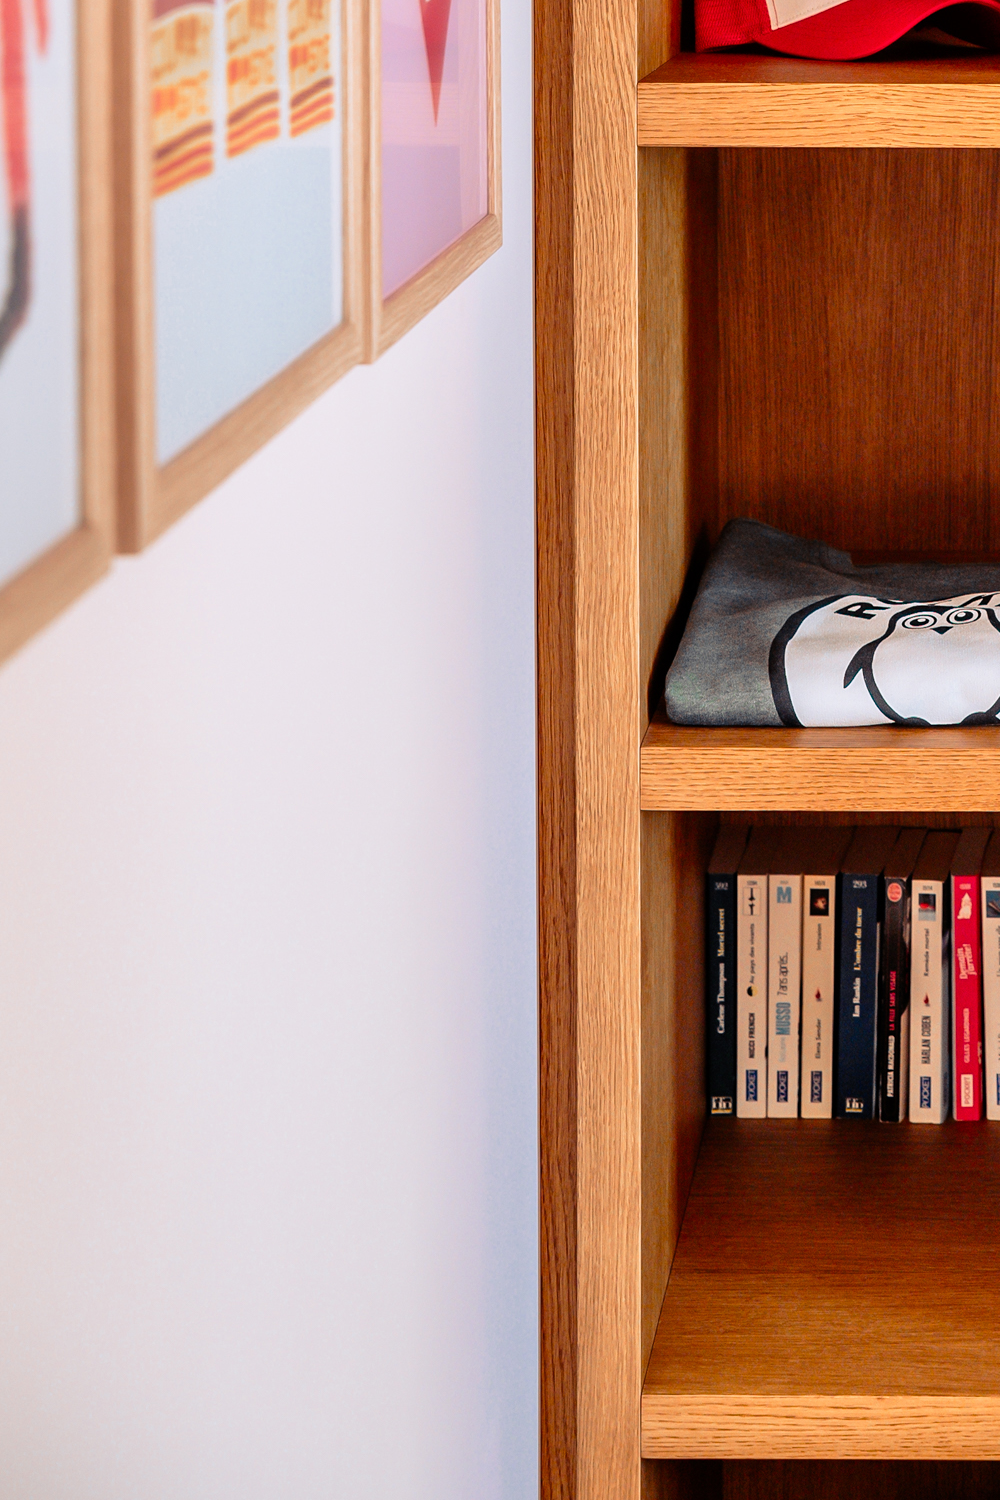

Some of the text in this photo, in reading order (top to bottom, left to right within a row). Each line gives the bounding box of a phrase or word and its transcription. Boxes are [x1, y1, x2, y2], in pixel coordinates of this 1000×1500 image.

[777, 886, 791, 903] M
[717, 931, 725, 957] Mortel
[855, 928, 862, 939] du
[854, 939, 862, 970] L'ombre
[957, 947, 969, 979] Demain
[717, 962, 727, 1003] Thompson
[750, 975, 755, 984] Au
[775, 1002, 791, 1035] MUSSO
[890, 1023, 895, 1031] LA
[922, 1016, 930, 1064] HARLAN COBEN
[747, 1070, 757, 1101] POCKET
[778, 1071, 787, 1102] POCKET
[811, 1071, 821, 1102] POCKET
[920, 1076, 930, 1108] POCKET
[963, 1076, 971, 1105] POCKET
